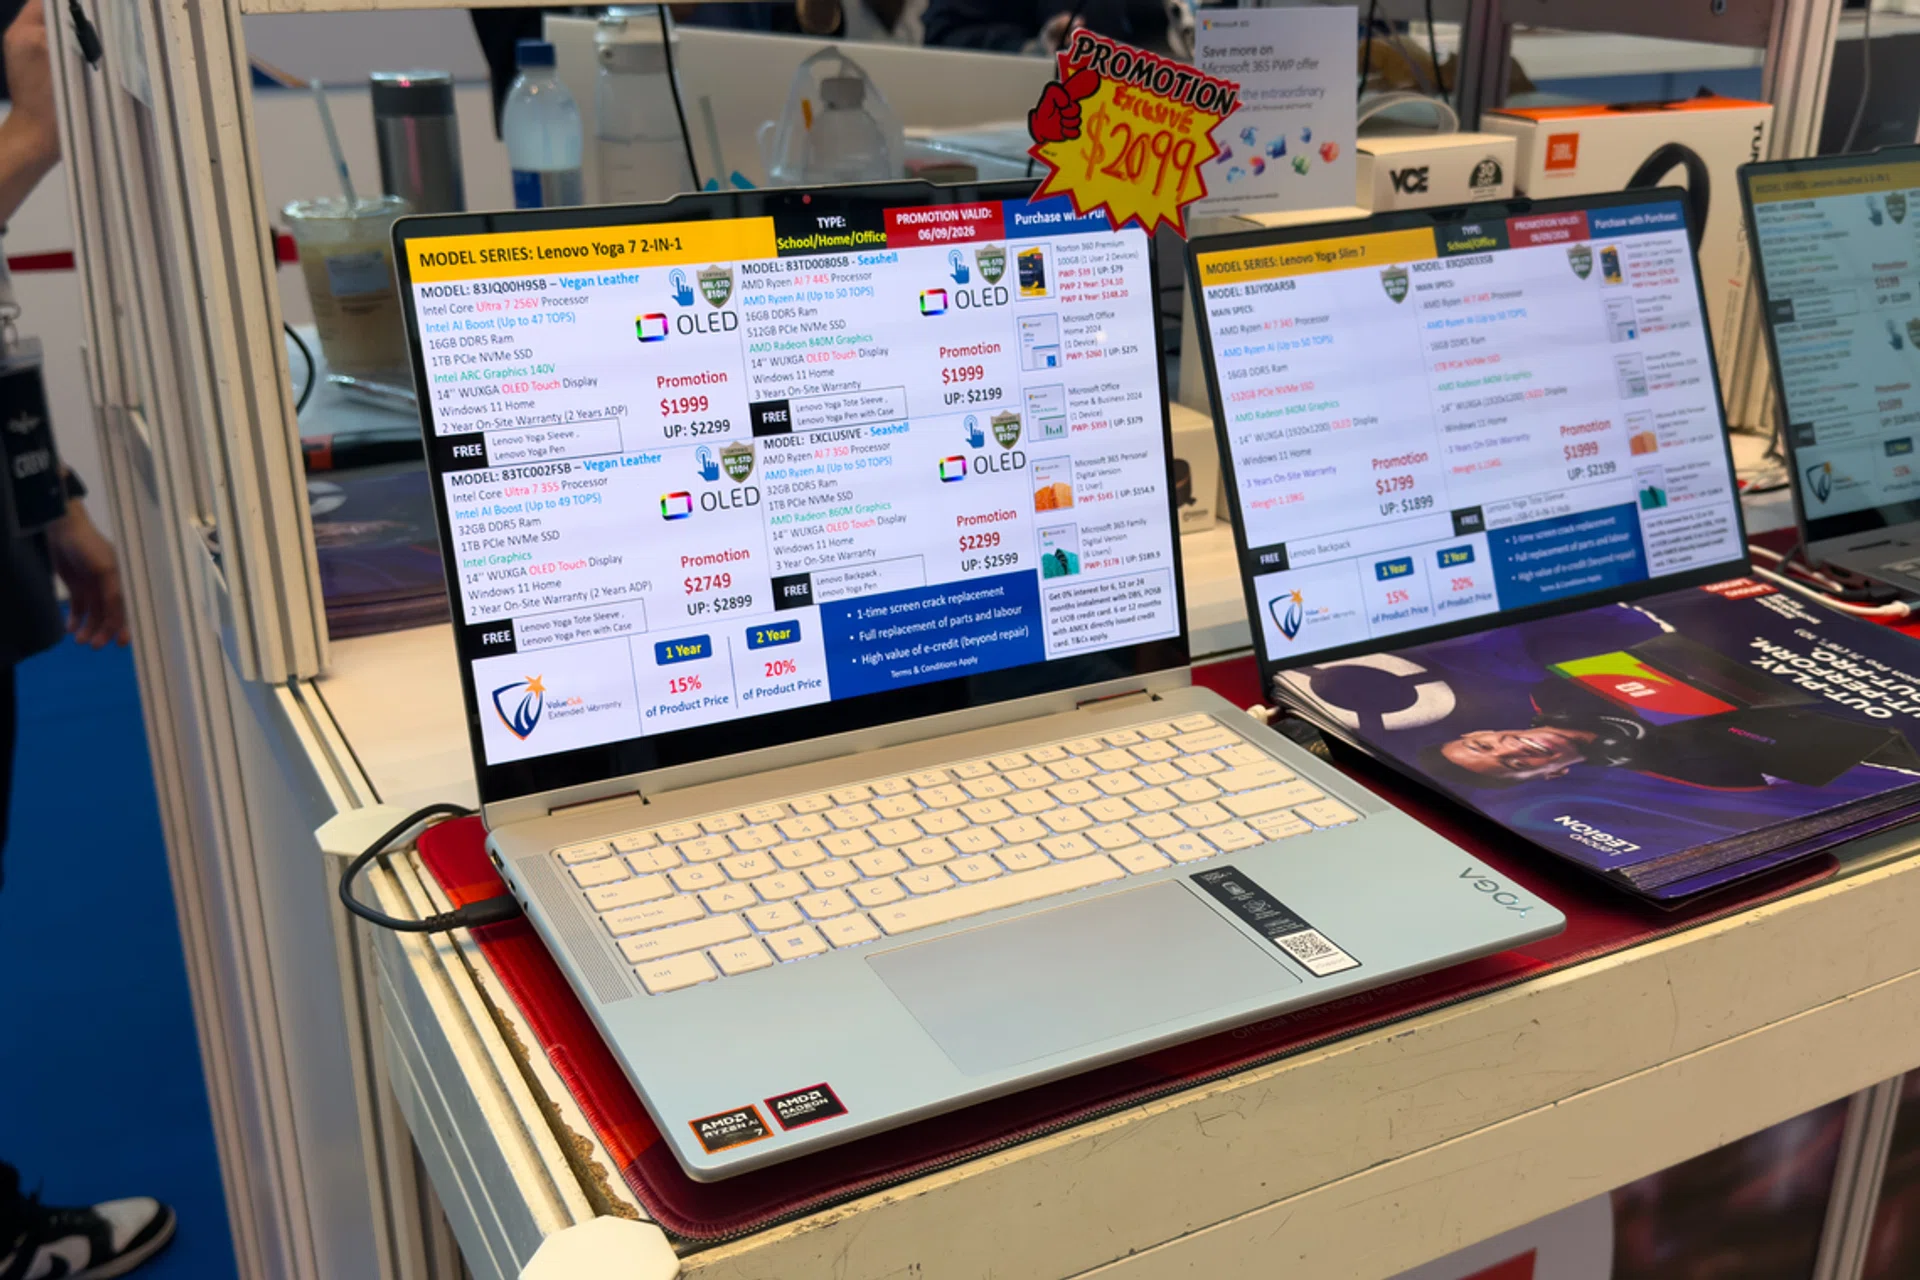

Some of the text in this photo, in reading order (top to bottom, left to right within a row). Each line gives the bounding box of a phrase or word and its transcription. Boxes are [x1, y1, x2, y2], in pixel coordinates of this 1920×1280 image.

[1203, 46, 1274, 58] Save more on
[1072, 37, 1237, 115] PROMOTION
[1202, 61, 1250, 74] Microsoft
[1272, 59, 1294, 71] PWP
[1296, 58, 1319, 70] offer
[1081, 102, 1196, 201] $2099
[816, 215, 846, 228] TYPE:
[896, 207, 992, 225] PROMOTION VALID:
[1014, 211, 1061, 225] Purchase
[776, 228, 888, 252] School/Home/Office
[917, 225, 976, 241] 06/09/2026
[419, 237, 682, 267] MODEL SERIES: Lenovo Yoga 7 2-IN-1
[1205, 260, 1242, 275] MODEL
[1243, 256, 1277, 271] SERIES:
[1279, 254, 1314, 266] Lenovo
[1314, 251, 1337, 263] Yoga
[1338, 247, 1358, 259] Slim
[741, 261, 784, 274] MODEL:
[857, 252, 898, 265] Seashell
[420, 284, 470, 298] MODEL:
[559, 277, 595, 290] Vegan
[597, 272, 639, 286] Leather
[1207, 285, 1245, 300] MODEL:
[422, 295, 589, 316] Intel Core Ultra 7 256V Processor
[954, 286, 1008, 309] OLED
[676, 310, 738, 335] OLED
[429, 333, 514, 350] 16GB DDR5 Ram
[939, 341, 1001, 358] Promotion
[431, 348, 533, 367] 1TB PCIe NVMe SSD
[433, 363, 555, 383] Intel ARC Graphics 140V
[656, 370, 727, 388] Promotion
[941, 364, 984, 385] $1999
[457, 384, 500, 398] WUXGA
[501, 381, 529, 394] OLED
[531, 380, 560, 390] Touch
[562, 376, 597, 388] Display
[943, 387, 1002, 405] UP: $2199
[660, 395, 708, 417] $1999
[762, 409, 787, 423] FREE
[663, 419, 730, 438] UP: $2299
[763, 422, 908, 449] MODEL: EXCLUSIVE Seashell
[1559, 419, 1611, 436] Promotion
[452, 443, 482, 458] FREE
[1371, 451, 1428, 470] Promotion
[1563, 440, 1599, 461] $1999
[450, 471, 499, 486] MODEL:
[583, 459, 618, 472] Vegan
[620, 453, 661, 466] Leather
[973, 450, 1026, 474] OLED
[1375, 474, 1414, 495] $1799
[700, 486, 760, 511] OLED
[1379, 494, 1433, 516] UP: $1899
[956, 508, 1017, 527] Promotion
[958, 531, 1000, 552] $2299
[680, 548, 750, 568] Promotion
[961, 552, 1018, 572] UP: $2599
[683, 572, 731, 595] $2749
[783, 582, 808, 597] FREE
[687, 594, 752, 616] UP: $2899
[857, 586, 1004, 619] 1-time screen crack replacement
[482, 629, 511, 644] FREE
[756, 629, 791, 644] 2 Year
[665, 644, 701, 659] 1 Year
[764, 659, 796, 677] 20%
[1750, 637, 1920, 718] UT-PERFORM.
[669, 675, 702, 694] 15%
[1751, 656, 1893, 719] OUT-PLAY.
[645, 695, 729, 718] of Product Price
[1553, 815, 1641, 852] LEGION
[1458, 867, 1534, 918] YOGA
[776, 1091, 810, 1110] AMD
[780, 1098, 829, 1115] RADEON
[701, 1113, 735, 1132] AMD
[704, 1122, 746, 1138] RYZEN
[753, 1128, 765, 1136] 7
